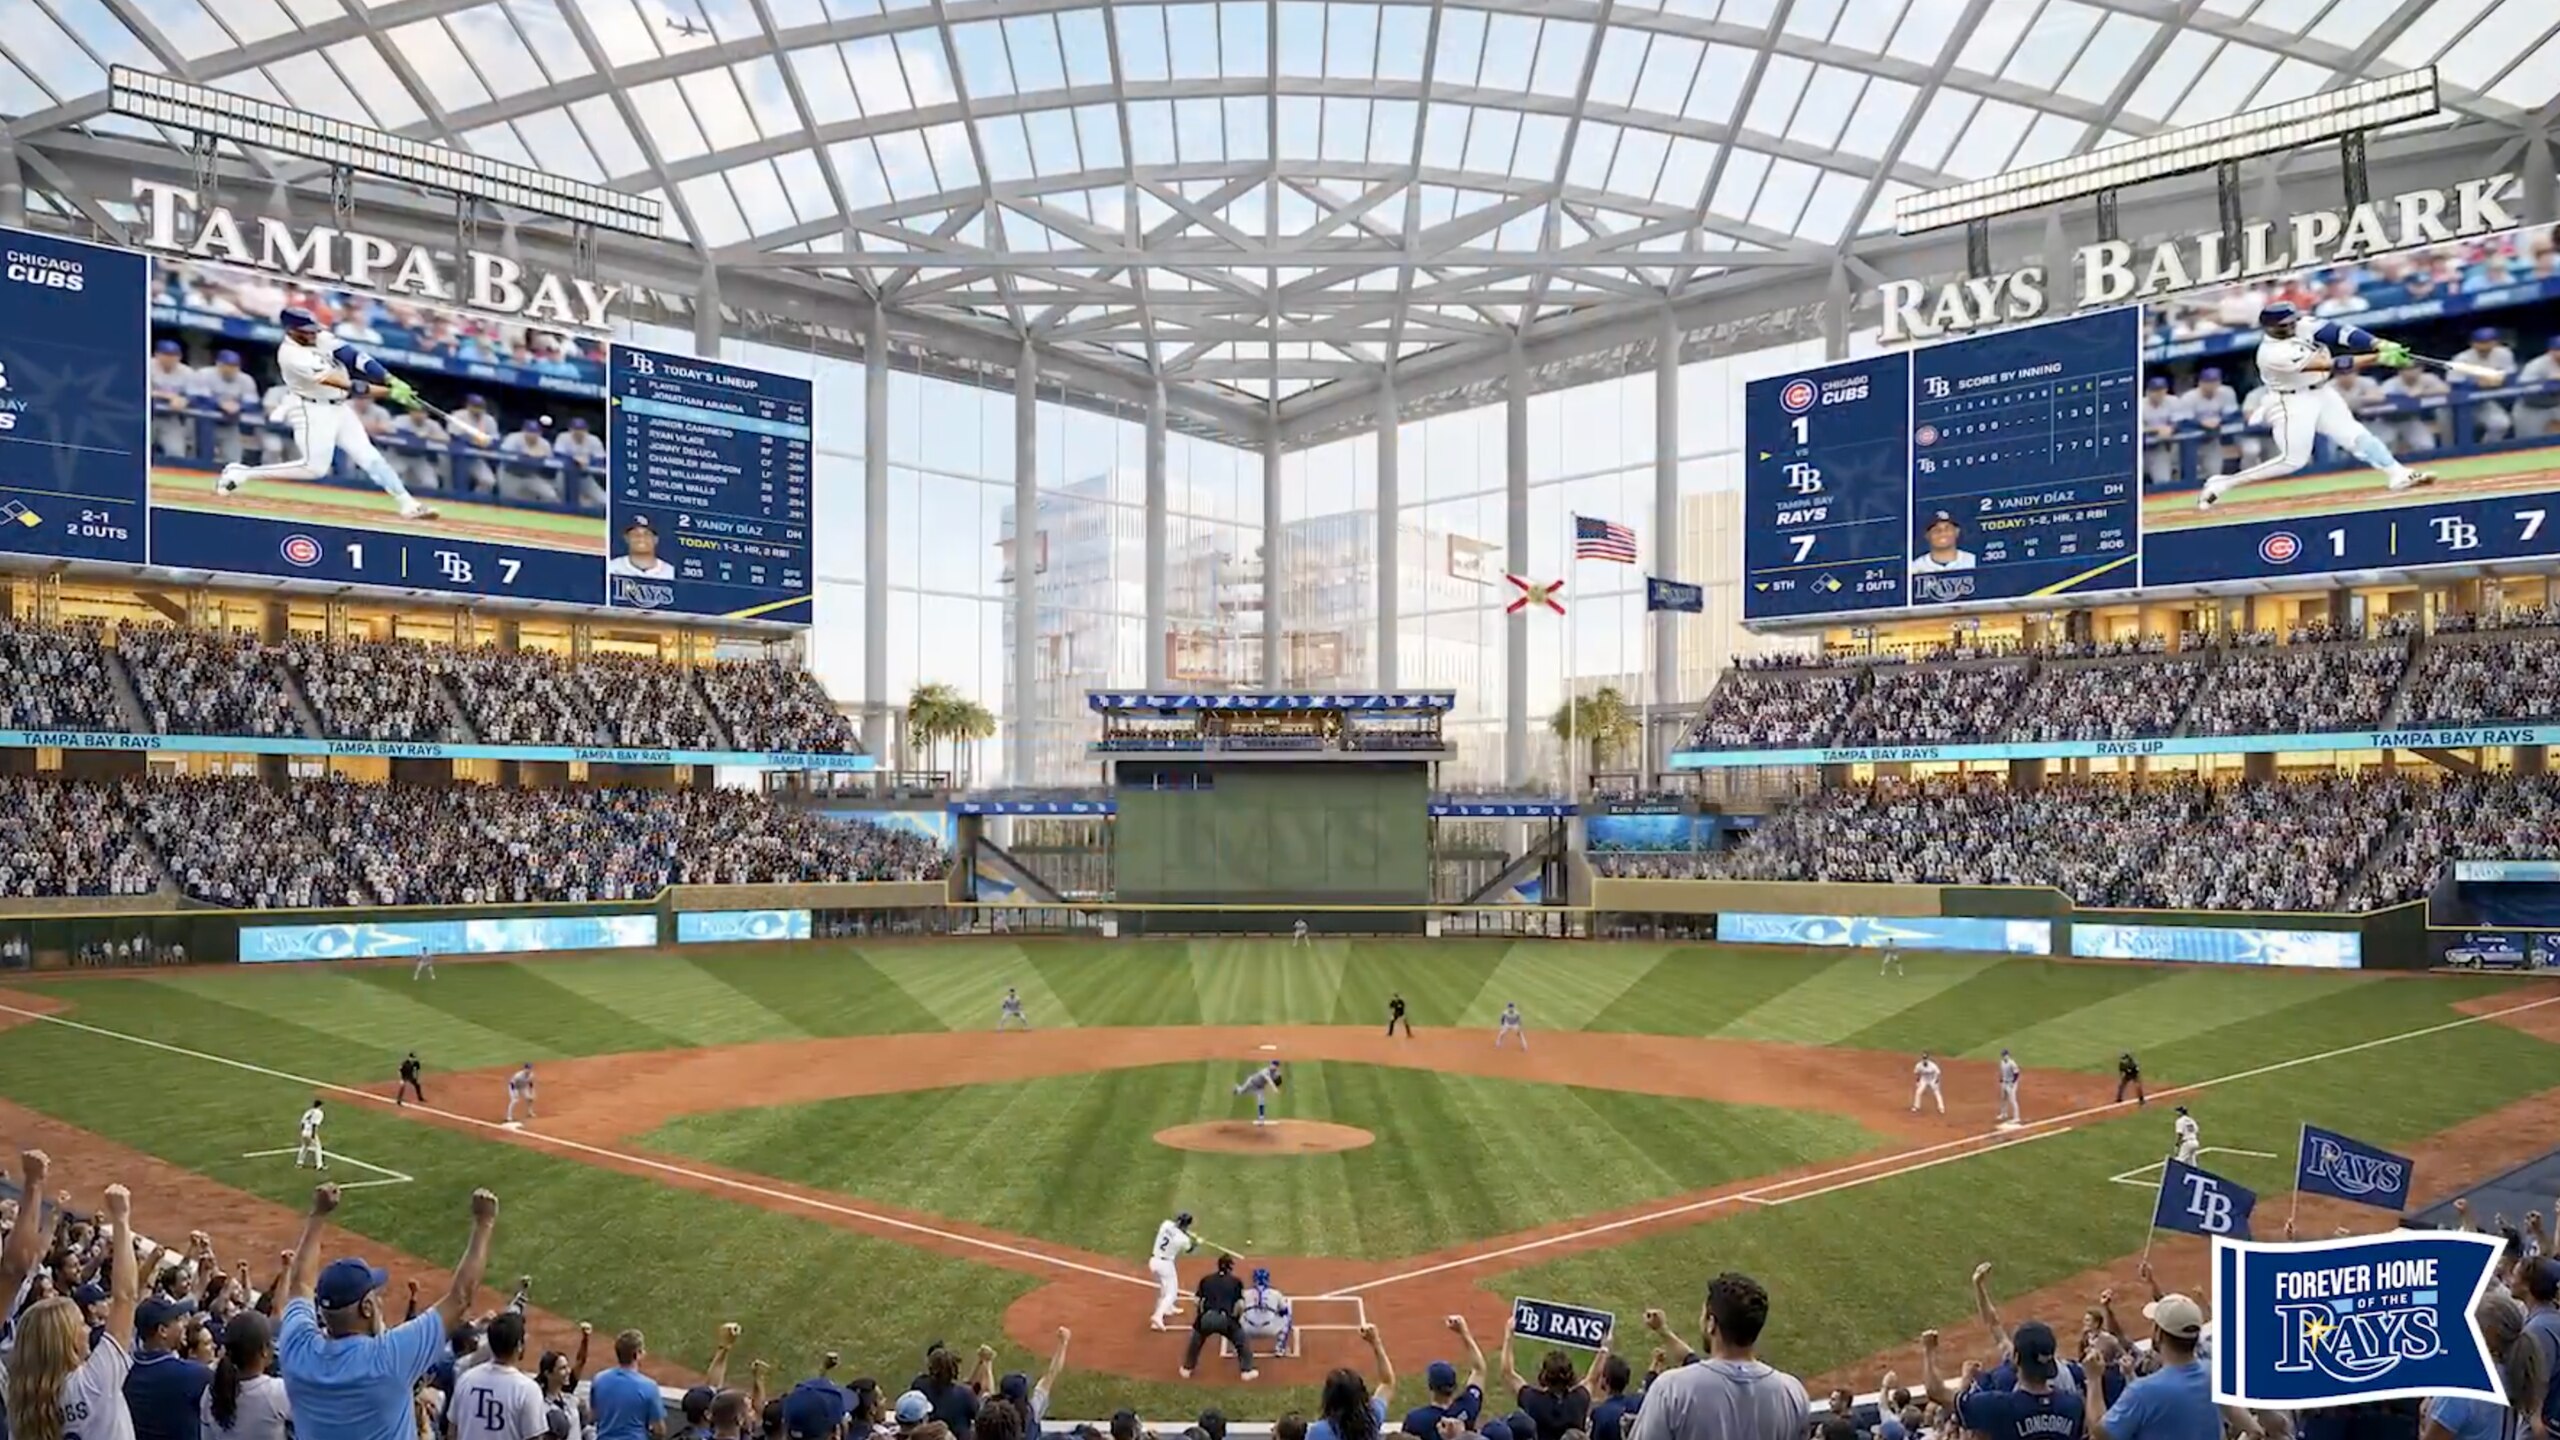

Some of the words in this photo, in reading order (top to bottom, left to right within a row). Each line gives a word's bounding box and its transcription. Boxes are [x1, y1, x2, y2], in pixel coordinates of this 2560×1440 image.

[7, 250, 83, 273] CHICAGO
[131, 178, 453, 300] TAMPA
[467, 250, 622, 331] BAY
[1877, 266, 2046, 344] RAYS
[2076, 174, 2518, 308] BALLPARK
[7, 264, 84, 291] CUBS
[626, 350, 655, 375] TB
[663, 364, 714, 383] TODAY'S
[716, 374, 758, 389] LINEUP
[1924, 376, 1950, 398] TB
[1958, 372, 1997, 389] SCORE
[2000, 370, 2017, 382] BY
[2018, 362, 2062, 379] INNING
[1822, 375, 1868, 391] CHICAGO
[652, 391, 703, 408] JONATHAN
[1822, 385, 1869, 405] CUBS
[1942, 429, 1949, 437] 0
[2058, 411, 2062, 419] 1
[2071, 409, 2078, 417] 3
[2085, 407, 2093, 415] 0
[2103, 404, 2110, 413] 2
[2122, 401, 2128, 409] 1
[1791, 416, 1809, 445] 1
[1917, 458, 1936, 474] TB
[2071, 442, 2078, 450] 7
[2085, 439, 2093, 447] 0
[2103, 437, 2110, 446] 2
[649, 479, 684, 490] TAYLOR
[1782, 462, 1822, 494] TB
[649, 491, 671, 503] NICK
[1776, 497, 1810, 511] TAMPA
[1812, 496, 1834, 506] BAY
[1980, 498, 1992, 511] 2
[1998, 495, 2040, 508] YANDY
[2044, 490, 2075, 503] DÍAZ
[2104, 484, 2123, 495] DH
[82, 510, 109, 523] 2-1
[678, 514, 690, 527] 2
[695, 518, 734, 533] YANDY
[786, 530, 802, 539] DH
[1776, 507, 1827, 525] RAYS
[1980, 518, 2026, 531] TODAY:
[2028, 516, 2050, 527] 1-2,
[2053, 513, 2073, 524] HR,
[2076, 512, 2084, 520] 2
[2087, 509, 2107, 518] RBI
[67, 524, 78, 535] 2
[83, 527, 128, 540] OUTS
[1985, 541, 2004, 549] AVG
[2024, 538, 2039, 546] HR
[2100, 530, 2121, 539] OPS
[2328, 529, 2345, 557] 1
[2429, 515, 2479, 550] TB
[2514, 510, 2546, 540] 7
[678, 537, 721, 550] TODAY:
[1789, 535, 1816, 563] 7
[2027, 549, 2035, 557] 6
[347, 543, 363, 569] 1
[434, 551, 473, 582] TB
[498, 559, 521, 583] 7
[1856, 583, 1864, 592] 2
[1866, 579, 1896, 592] OUTS
[1865, 569, 1884, 580] 2-1
[613, 577, 674, 608] RAYS
[1914, 575, 1975, 602] RAYS
[23, 733, 80, 748] TAMPA
[83, 734, 117, 748] BAY
[120, 735, 161, 749] RAYS
[329, 741, 375, 754] TAMPA
[379, 742, 403, 754] BAY
[406, 743, 441, 756] RAYS
[2096, 741, 2139, 754] RAYS
[2141, 740, 2163, 753] UP
[2371, 733, 2434, 747] TAMPA
[2440, 731, 2477, 745] BAY
[2483, 729, 2534, 743] RAYS
[574, 749, 612, 760] TAMPA
[617, 749, 639, 760] BAY
[642, 750, 671, 762] RAYS
[768, 754, 804, 766] TAMPA
[807, 755, 826, 766] BAY
[829, 756, 855, 767] RAYS
[1822, 749, 1868, 761] TAMPA
[1871, 748, 1899, 760] BAY
[1901, 747, 1939, 759] RAYS
[2307, 1137, 2402, 1195] RAYS
[2183, 1173, 2233, 1234] TB
[1160, 1236, 1170, 1251] 2
[1519, 1305, 1540, 1332] TB
[1550, 1313, 1604, 1341] RAYS
[470, 1386, 505, 1431] TB
[2016, 1414, 2073, 1438] LONGORIA
